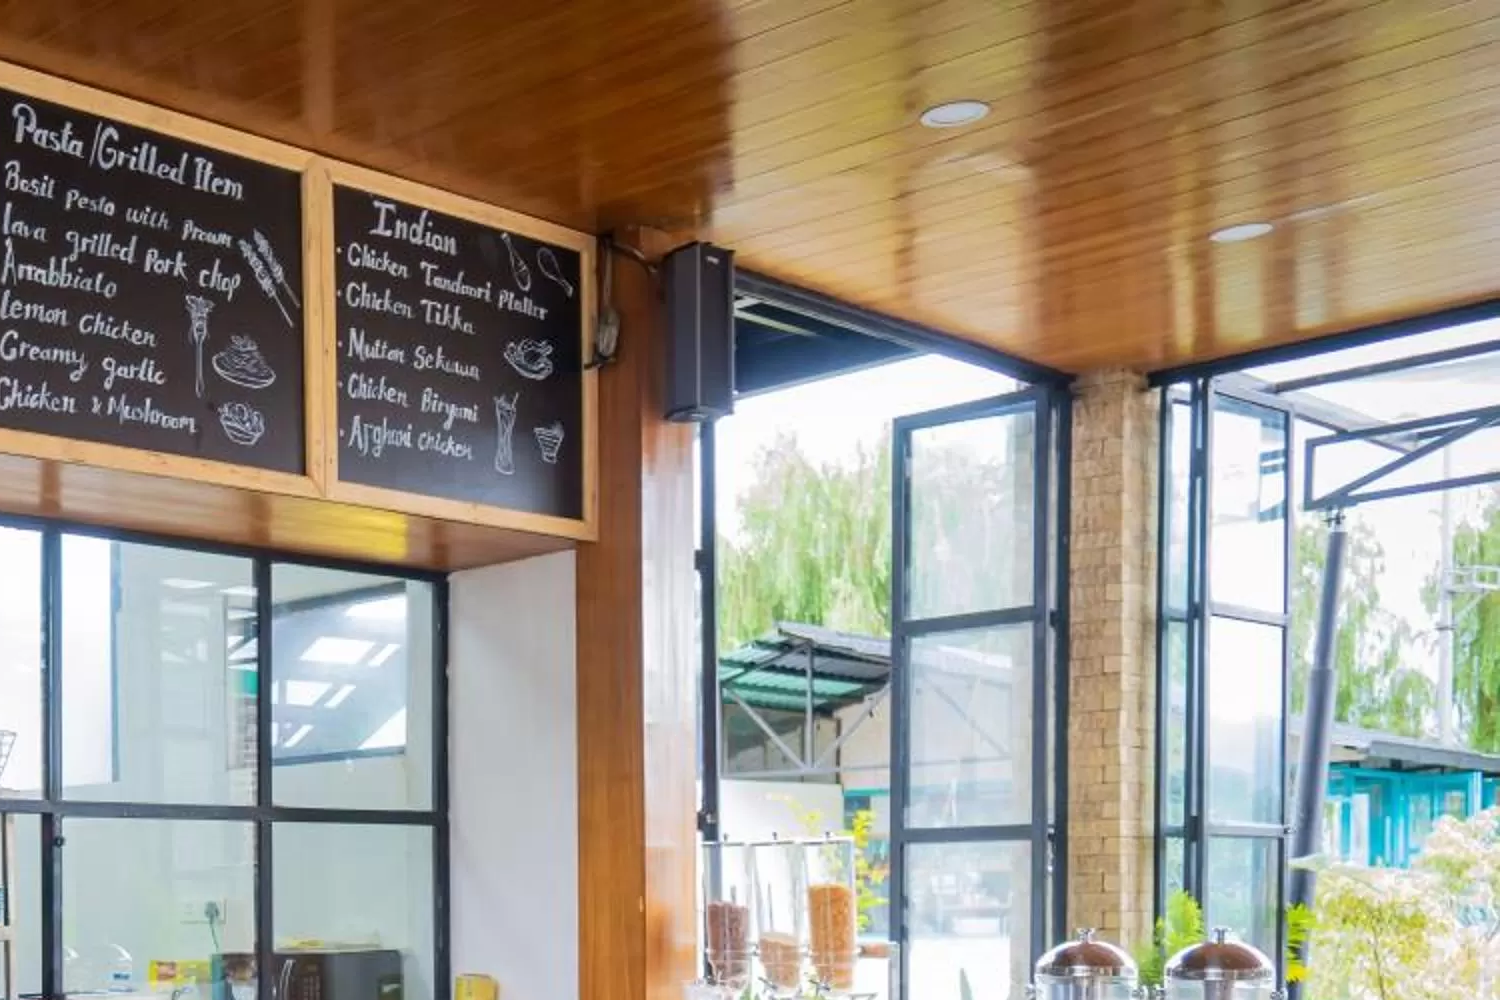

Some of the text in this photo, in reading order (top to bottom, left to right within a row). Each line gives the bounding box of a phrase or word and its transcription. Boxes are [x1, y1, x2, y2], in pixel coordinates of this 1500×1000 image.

[11, 103, 86, 161] Pasta
[194, 157, 245, 202] Item
[65, 230, 138, 264] grilled
[369, 201, 459, 257] Indian
